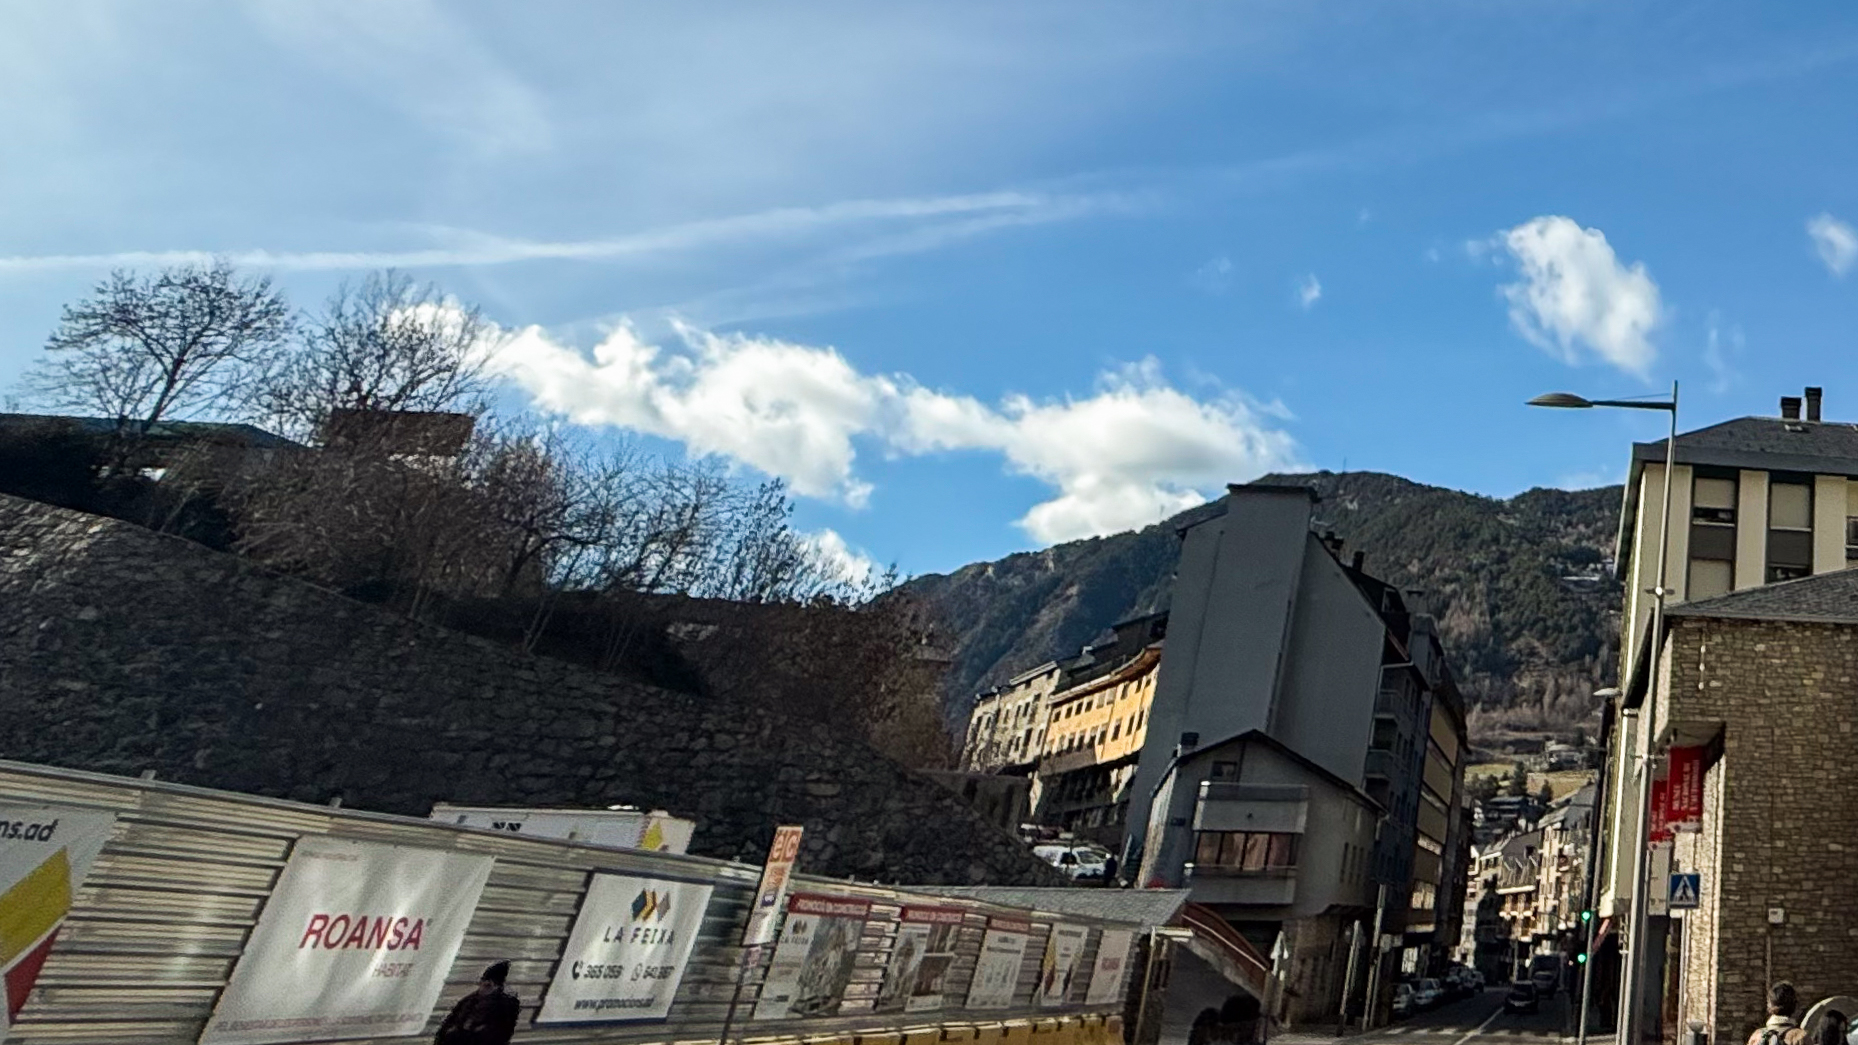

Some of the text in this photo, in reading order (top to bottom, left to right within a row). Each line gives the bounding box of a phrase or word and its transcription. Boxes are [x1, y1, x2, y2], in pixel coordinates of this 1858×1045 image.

[299, 913, 424, 951] ROANSA
[603, 926, 675, 945] LA FEIXA
